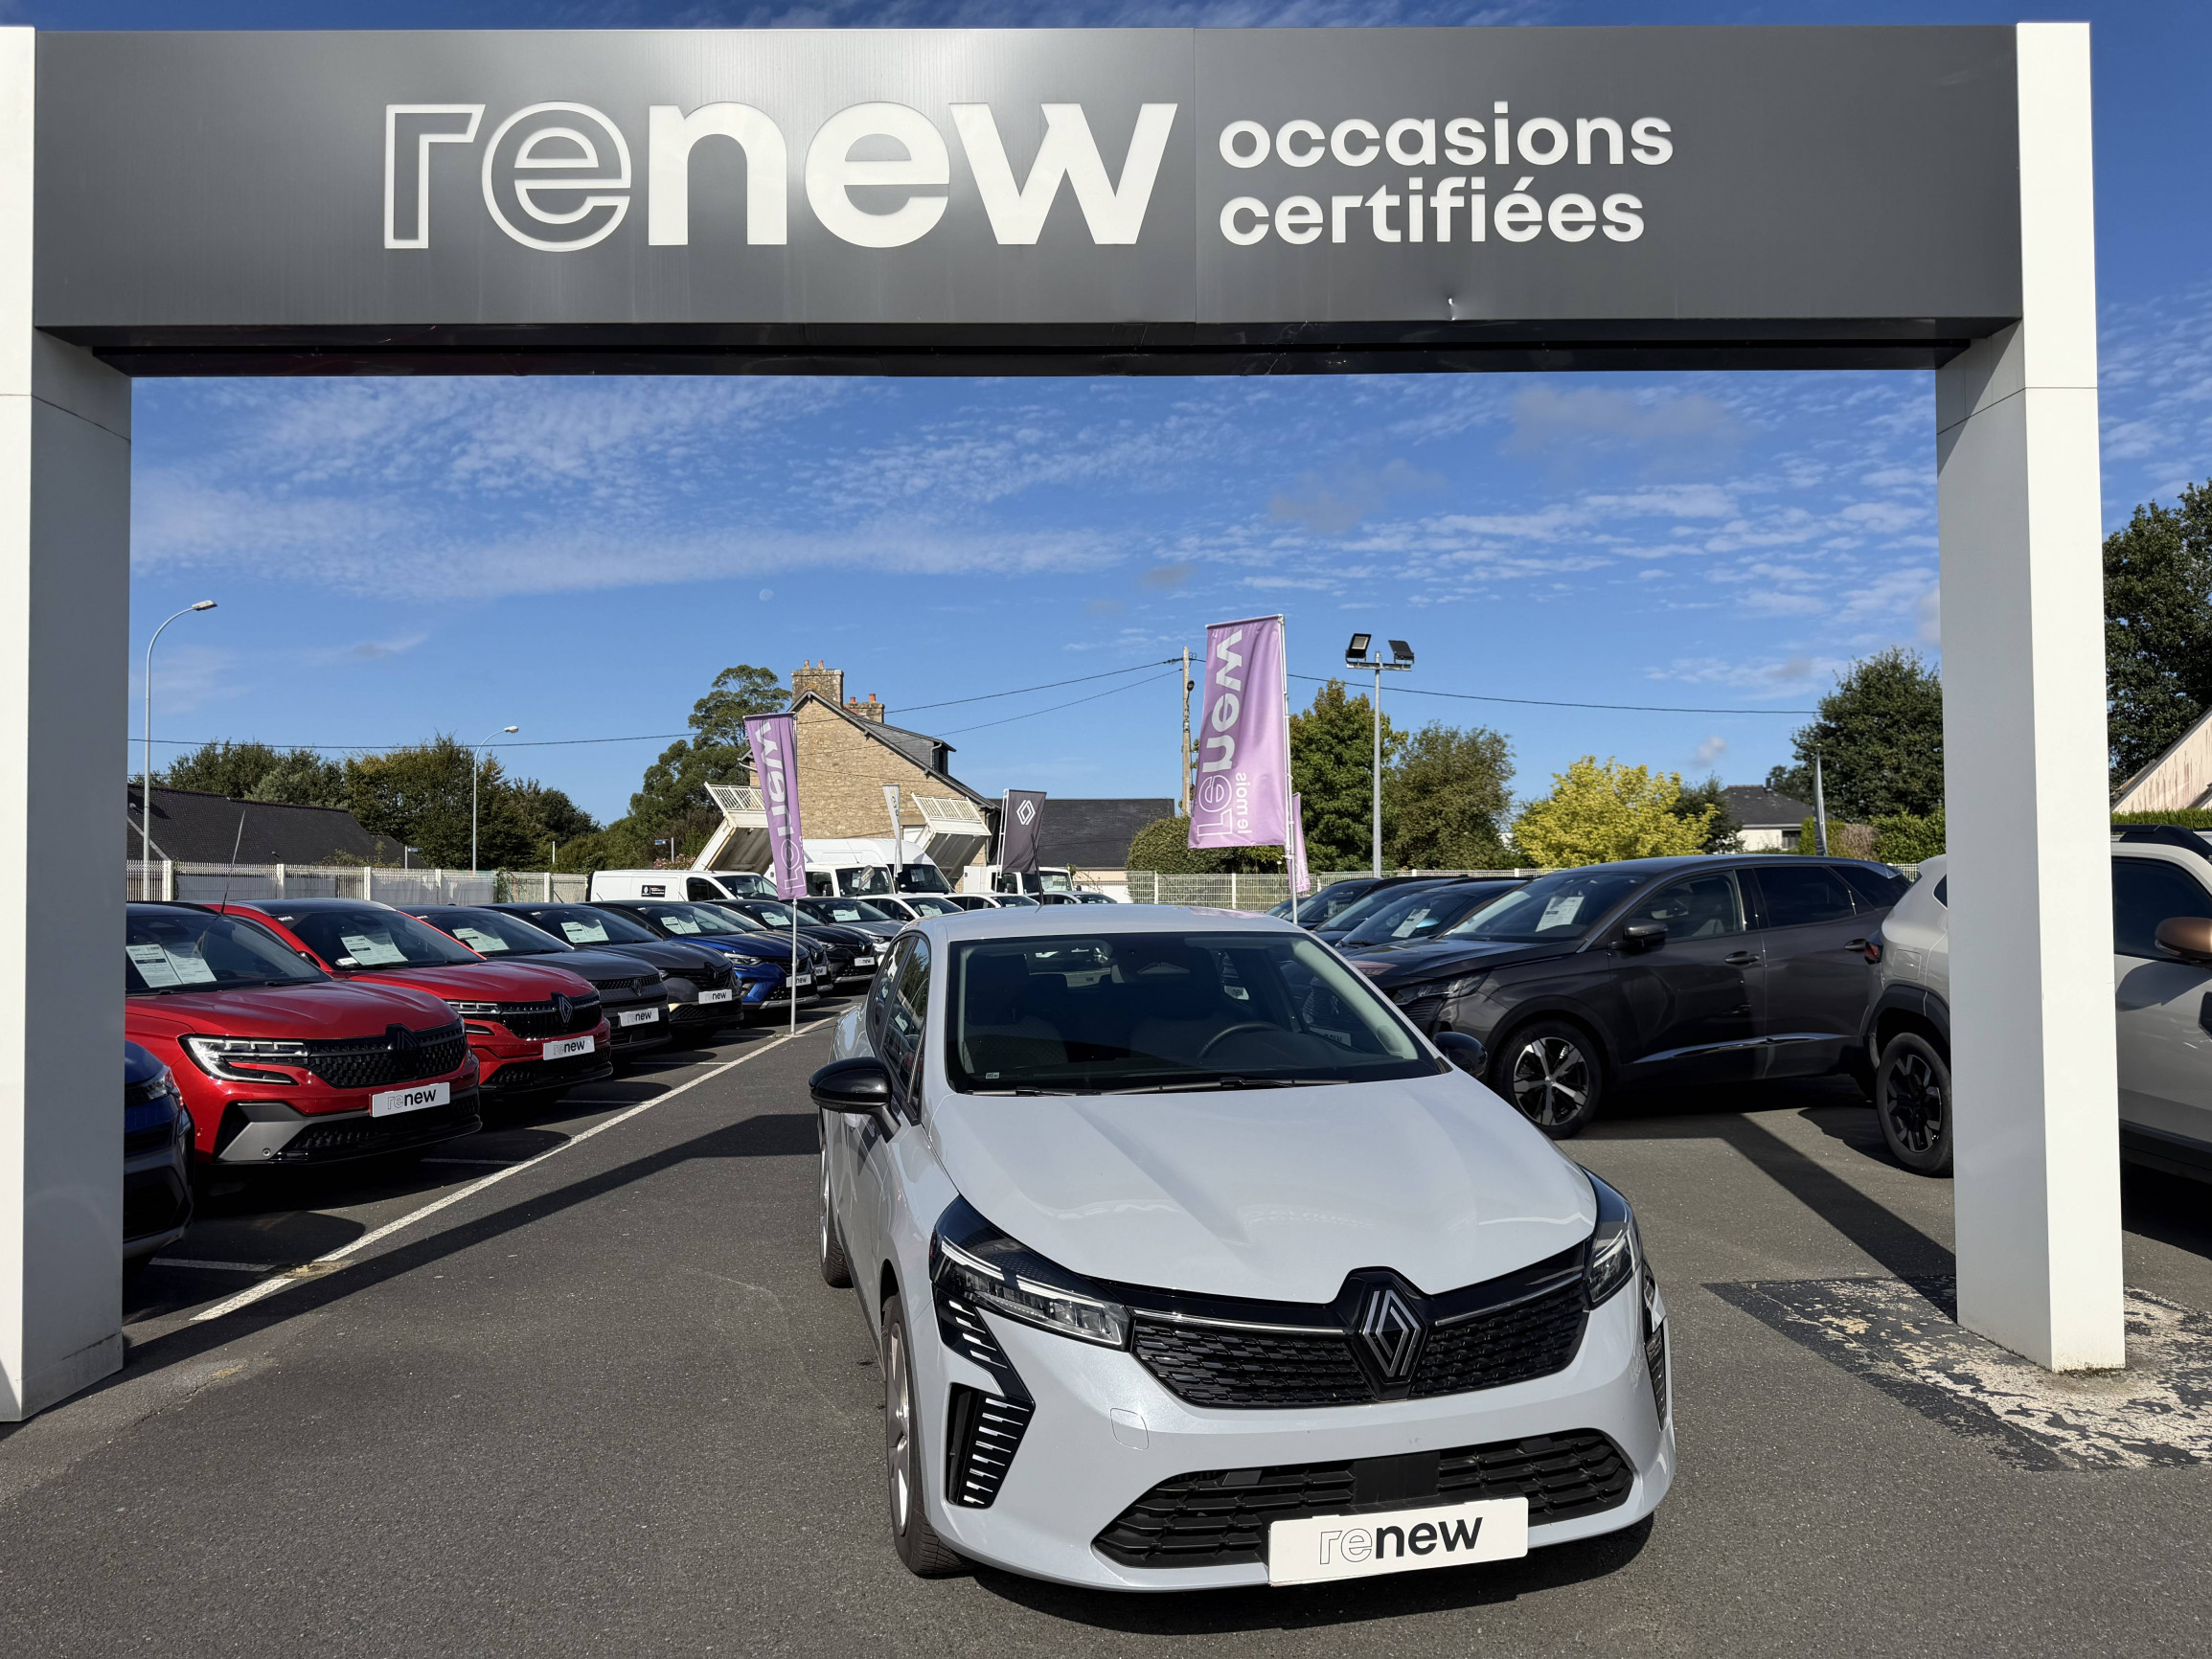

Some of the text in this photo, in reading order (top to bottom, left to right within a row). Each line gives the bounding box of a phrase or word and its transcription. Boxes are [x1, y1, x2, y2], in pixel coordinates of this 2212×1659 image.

[1219, 102, 1673, 169] occasions
[383, 101, 1178, 253] renew
[1220, 176, 1644, 246] certifiées
[554, 1040, 585, 1056] renew
[387, 1089, 437, 1110] renew
[1319, 1517, 1484, 1565] renew
